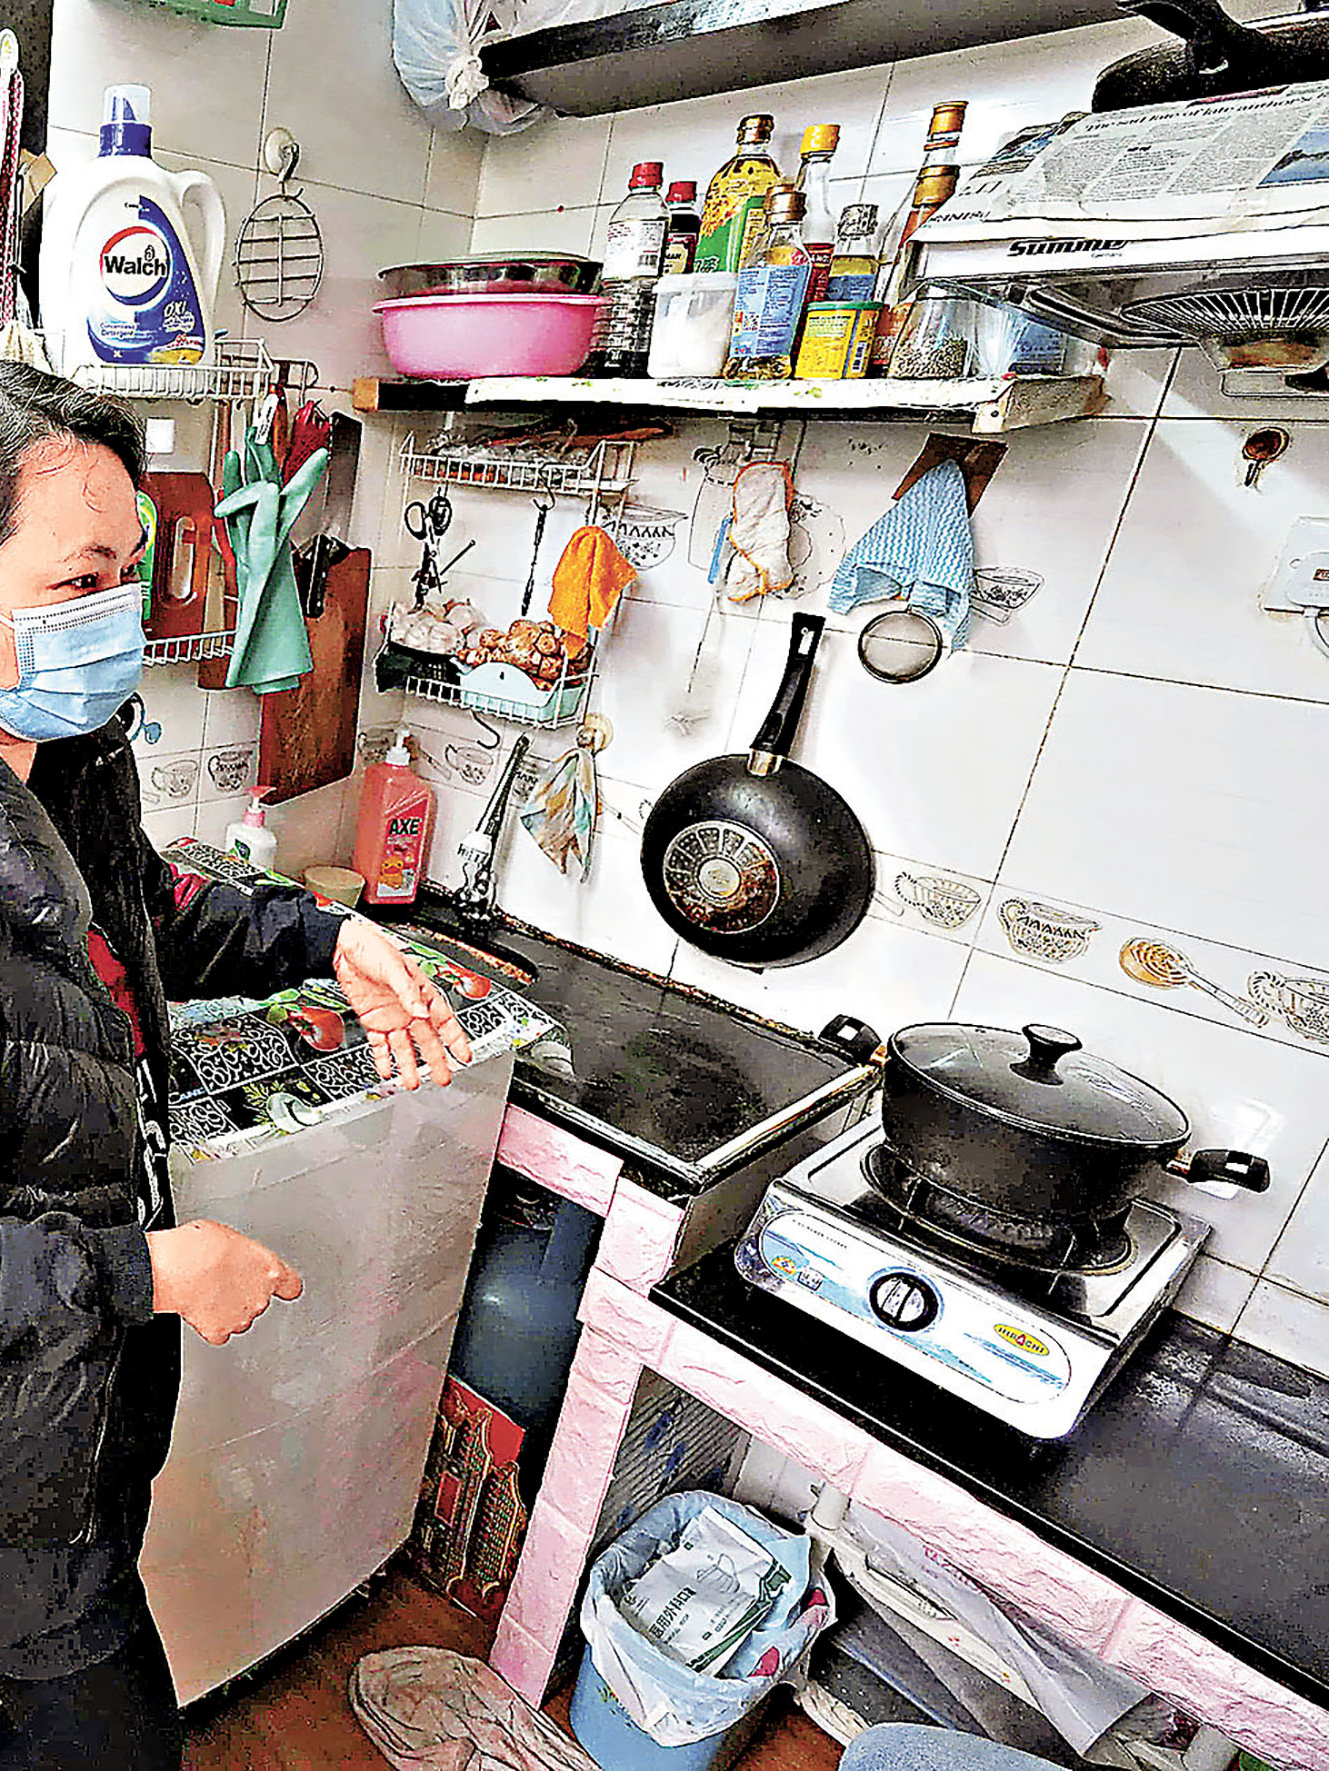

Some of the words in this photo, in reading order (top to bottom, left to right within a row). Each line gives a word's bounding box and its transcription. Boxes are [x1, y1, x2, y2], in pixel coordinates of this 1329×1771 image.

[104, 254, 168, 276] Walch
[164, 300, 187, 318] OXI
[389, 818, 422, 835] AXE
